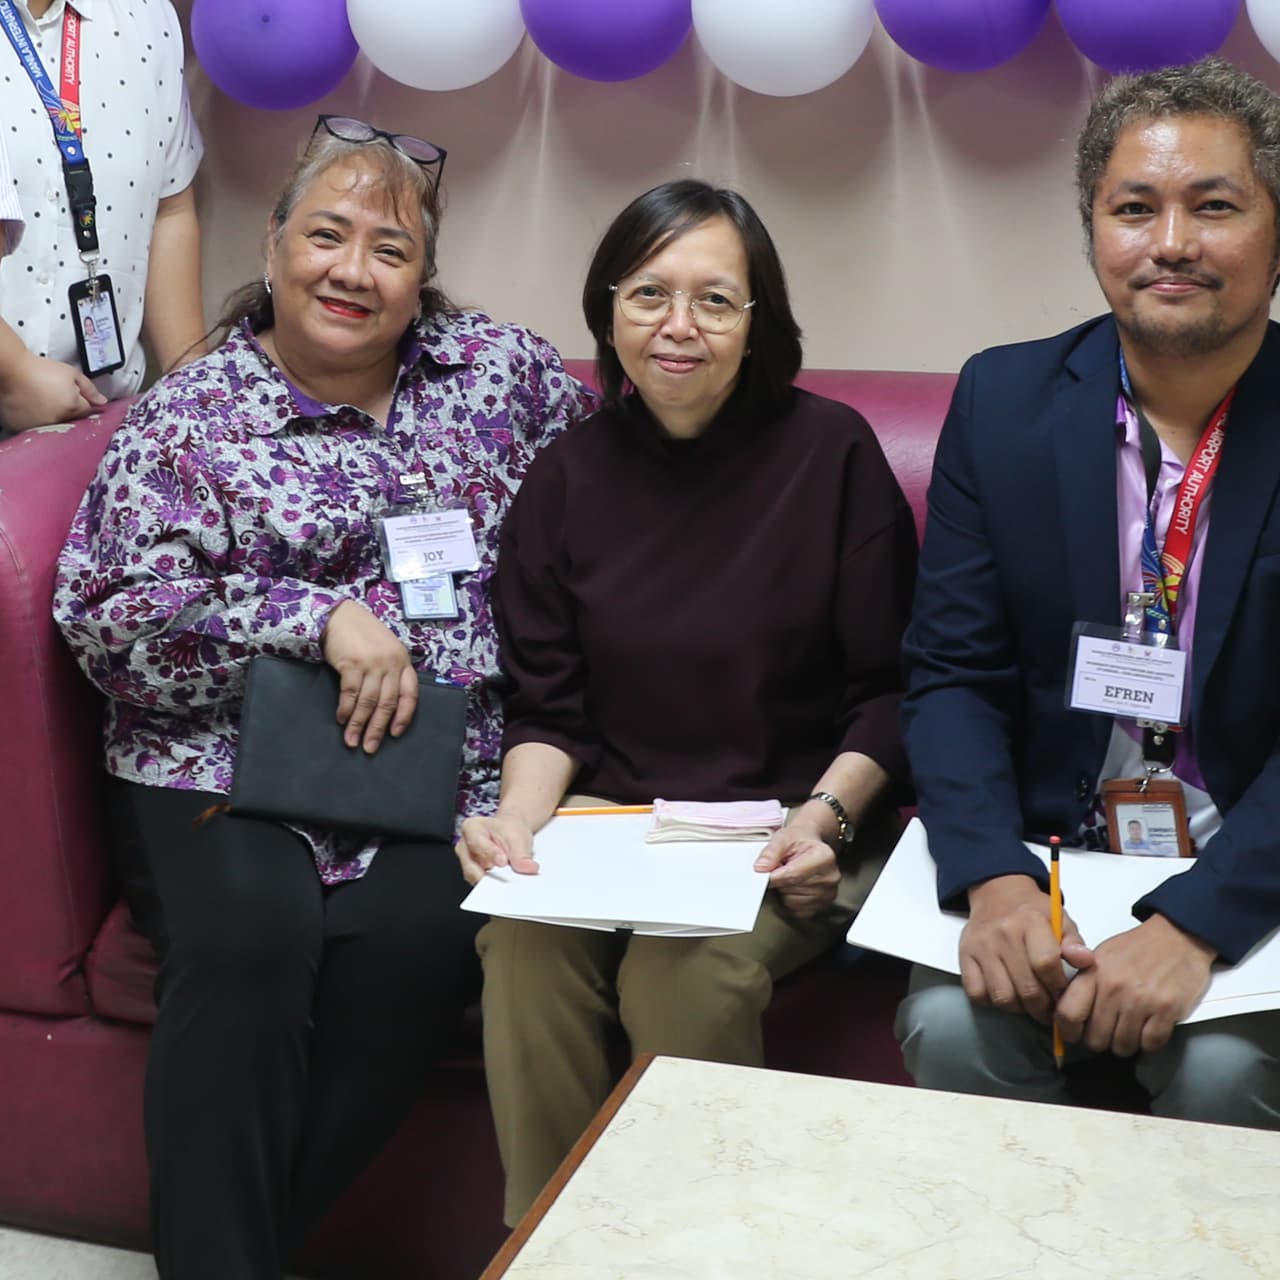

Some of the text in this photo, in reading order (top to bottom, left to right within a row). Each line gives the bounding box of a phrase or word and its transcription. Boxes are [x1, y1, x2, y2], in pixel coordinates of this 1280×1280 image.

[64, 37, 76, 86] AUTHORITY
[1195, 431, 1225, 473] AIRPORT
[1175, 469, 1205, 536] AUTHORITY
[423, 550, 445, 563] JOY
[1104, 685, 1155, 704] EFREN
